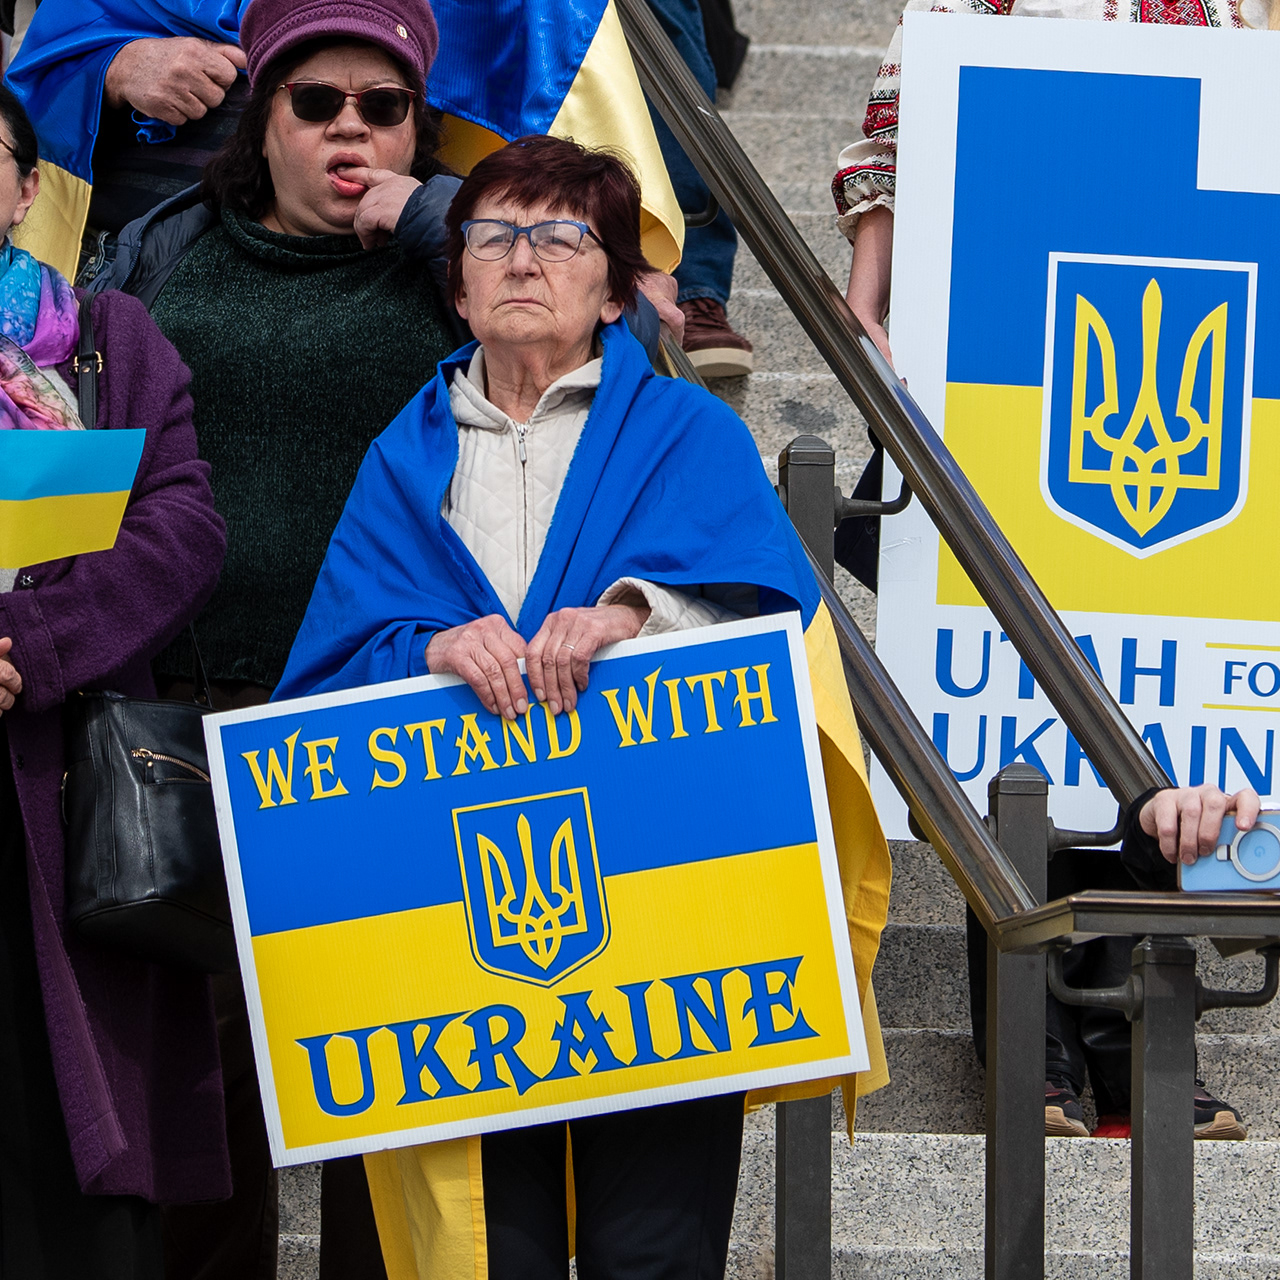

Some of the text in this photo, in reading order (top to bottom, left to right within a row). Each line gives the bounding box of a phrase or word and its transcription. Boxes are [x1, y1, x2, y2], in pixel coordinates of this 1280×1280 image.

[241, 662, 780, 812] WE STAND WITH
[294, 955, 822, 1118] UKRAINE
